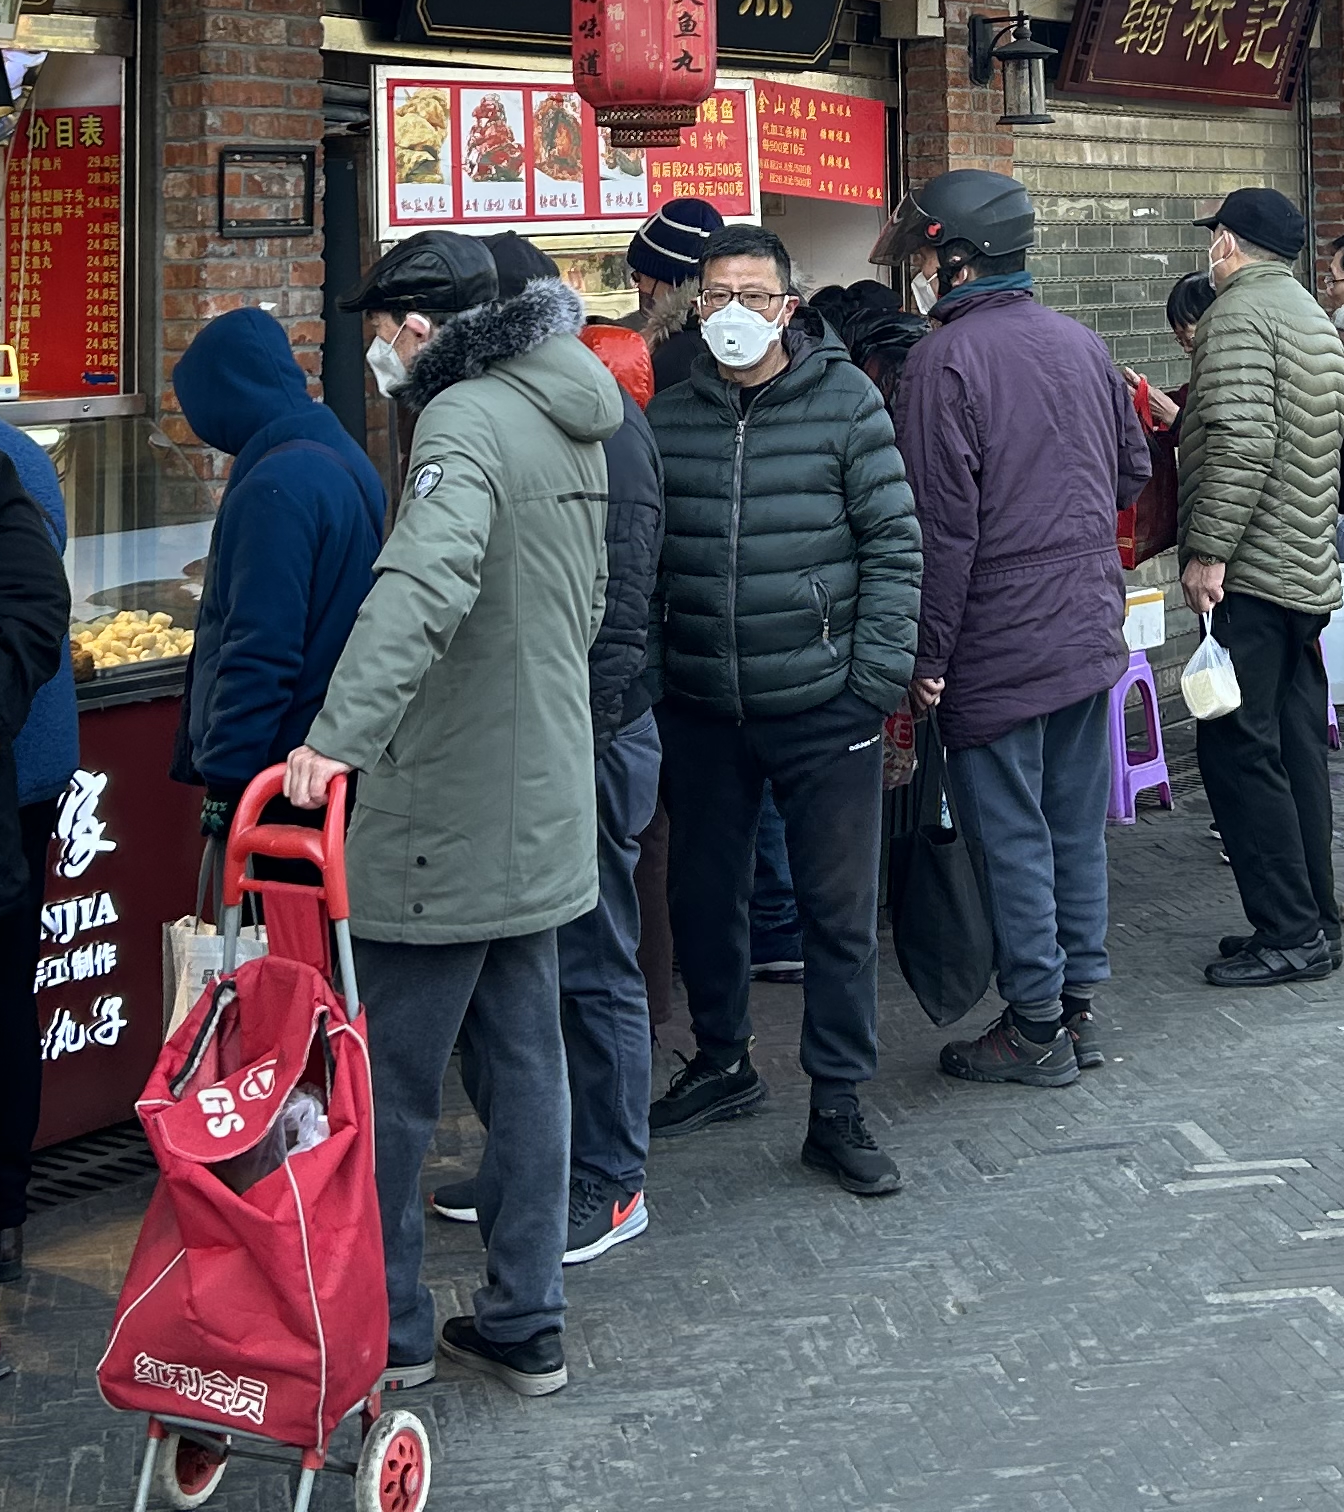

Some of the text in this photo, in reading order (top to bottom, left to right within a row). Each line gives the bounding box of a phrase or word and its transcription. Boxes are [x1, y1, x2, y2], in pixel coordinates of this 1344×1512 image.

[696, 97, 736, 124] 爆鱼
[757, 89, 818, 121] 金山爆鱼
[26, 114, 103, 148] 价目表
[134, 1351, 268, 1425] 红利会员
